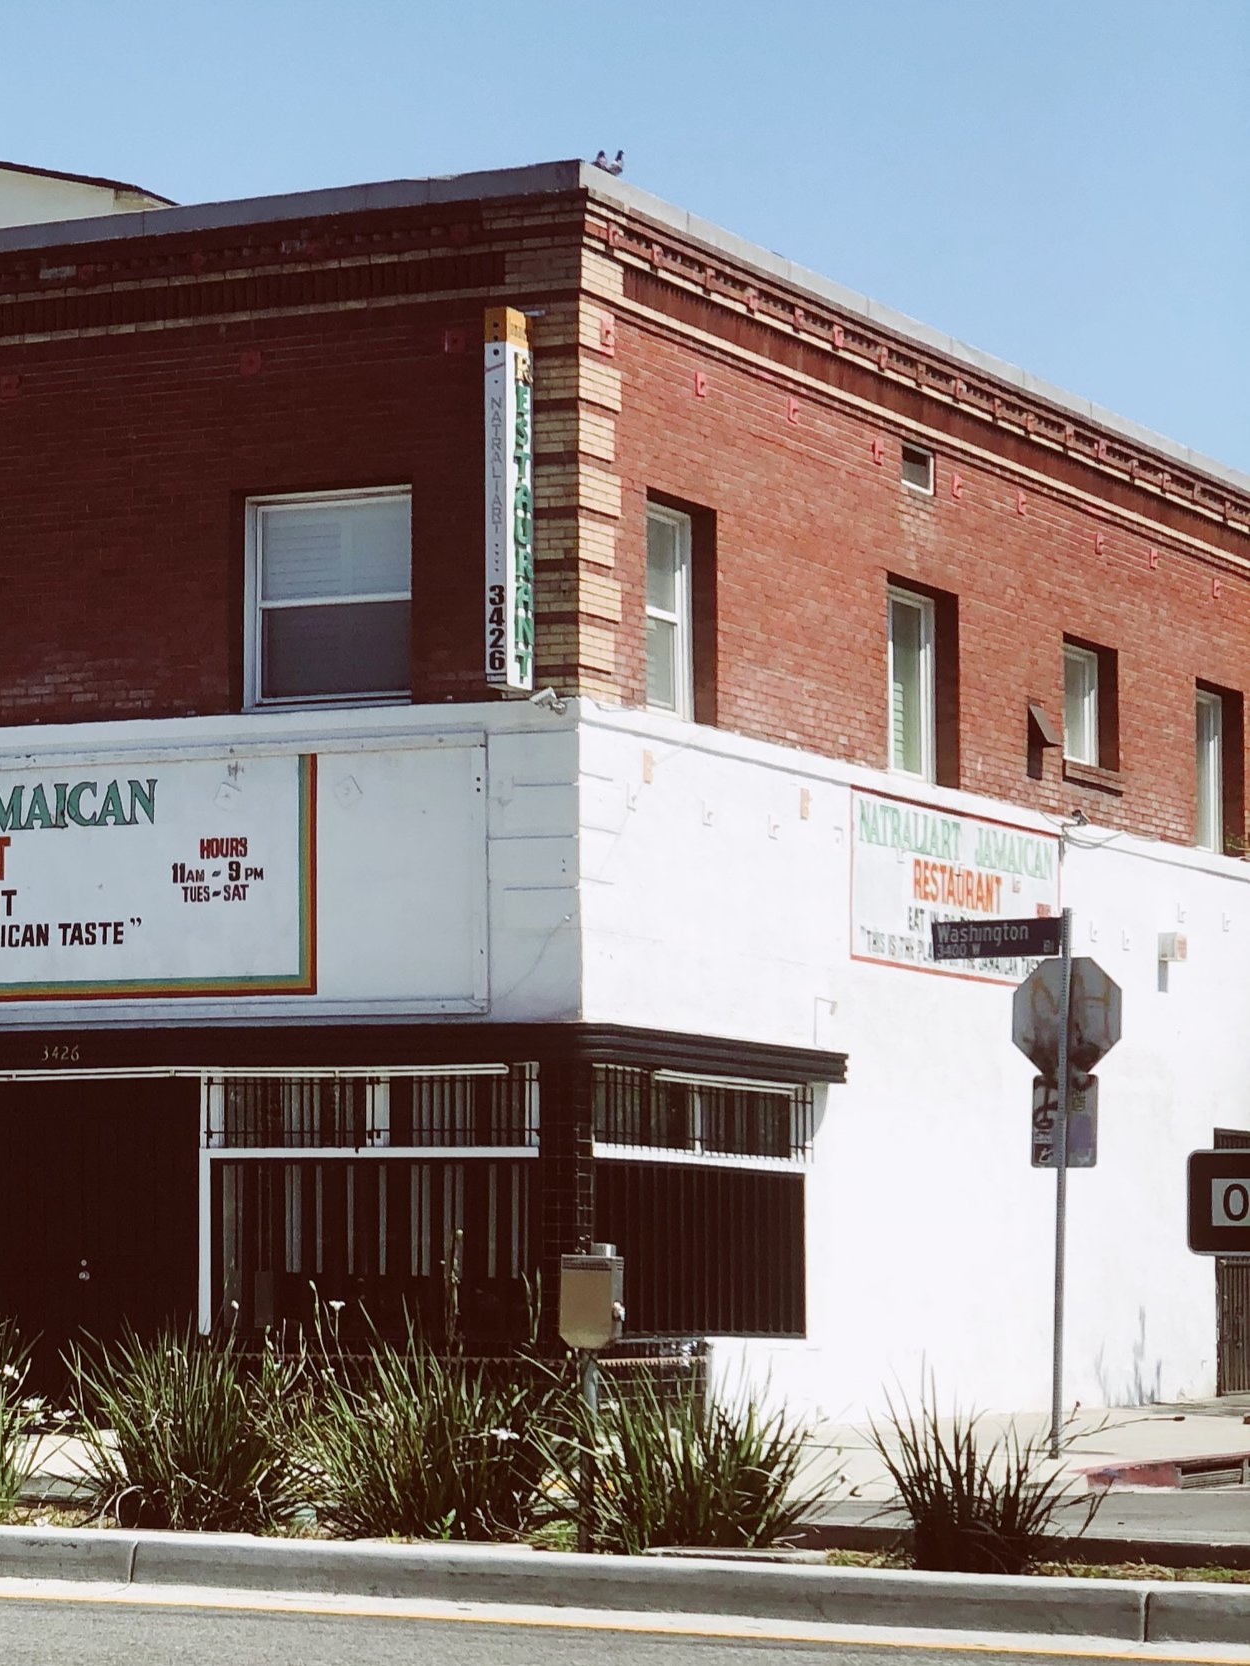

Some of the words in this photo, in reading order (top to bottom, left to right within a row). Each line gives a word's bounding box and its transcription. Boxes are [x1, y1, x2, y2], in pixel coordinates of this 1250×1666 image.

[490, 397, 502, 534] NATRALIART
[513, 351, 535, 683] RESTAURANT
[488, 583, 505, 671] 3426
[200, 837, 248, 860] HOURS
[858, 800, 961, 861] NATRALIART
[975, 826, 1054, 881] JAMAICAN
[913, 858, 1002, 915] RESTAURANT
[937, 922, 1029, 947] Washington
[41, 1044, 80, 1061] 3426
